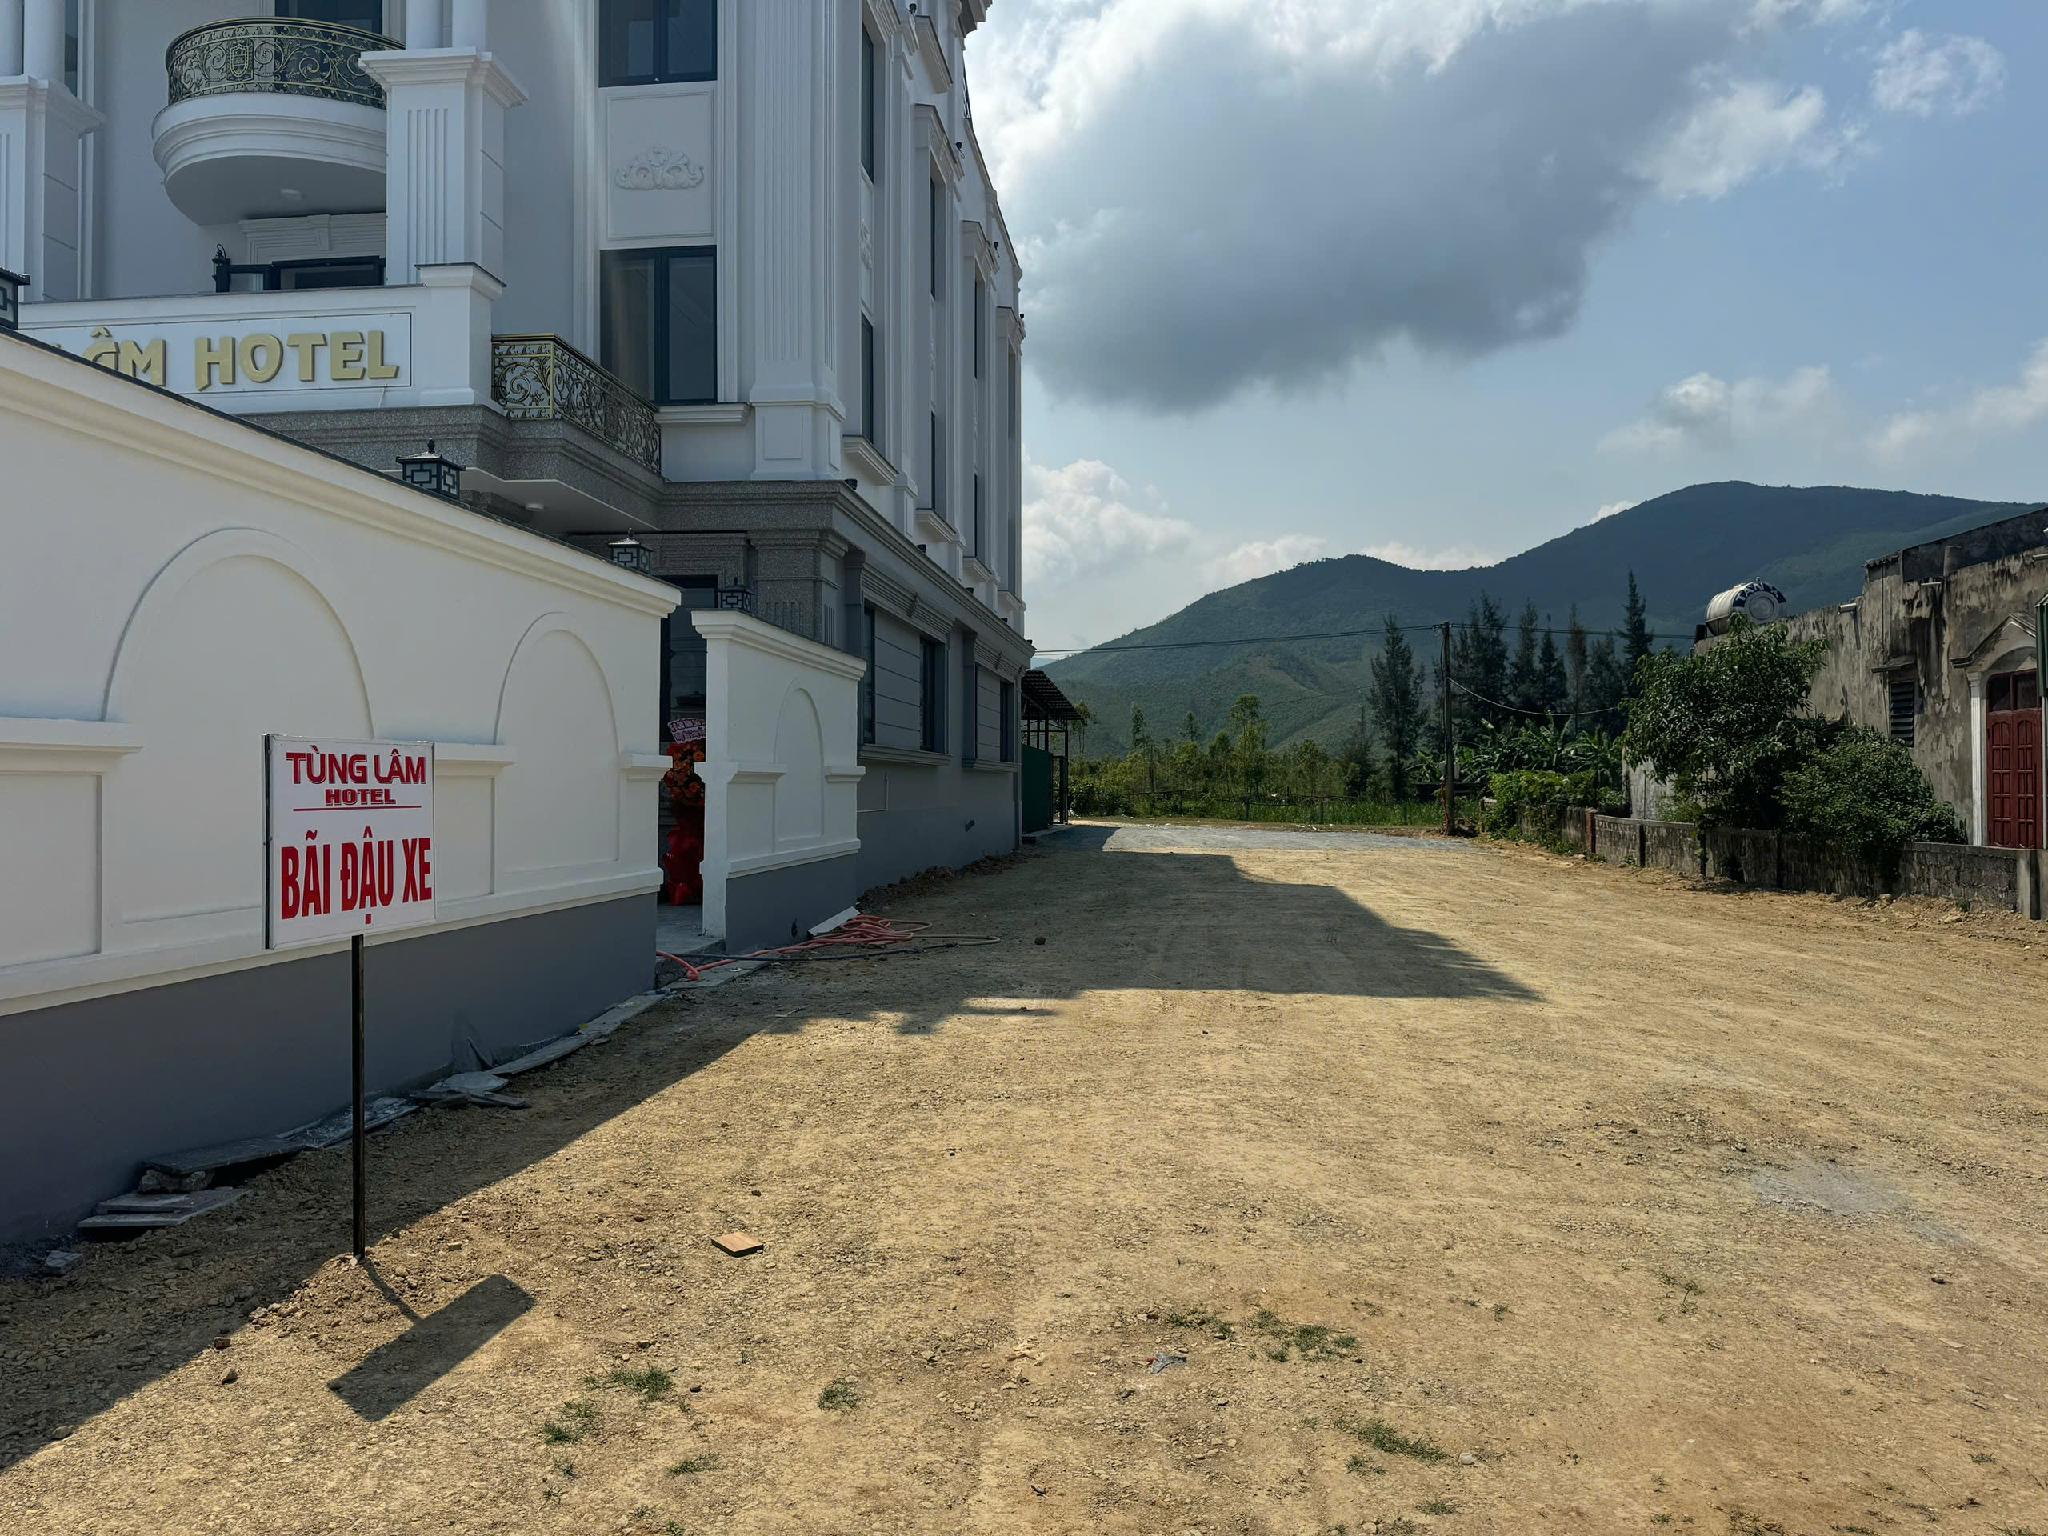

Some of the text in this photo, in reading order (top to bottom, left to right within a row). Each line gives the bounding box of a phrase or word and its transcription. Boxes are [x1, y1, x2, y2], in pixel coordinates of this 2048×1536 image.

[54, 326, 399, 391] ÂM HOTEL
[286, 745, 427, 785] TÙNG LÂM
[325, 788, 397, 806] HOTEL
[281, 825, 432, 925] BÃI ĐẬU XE
